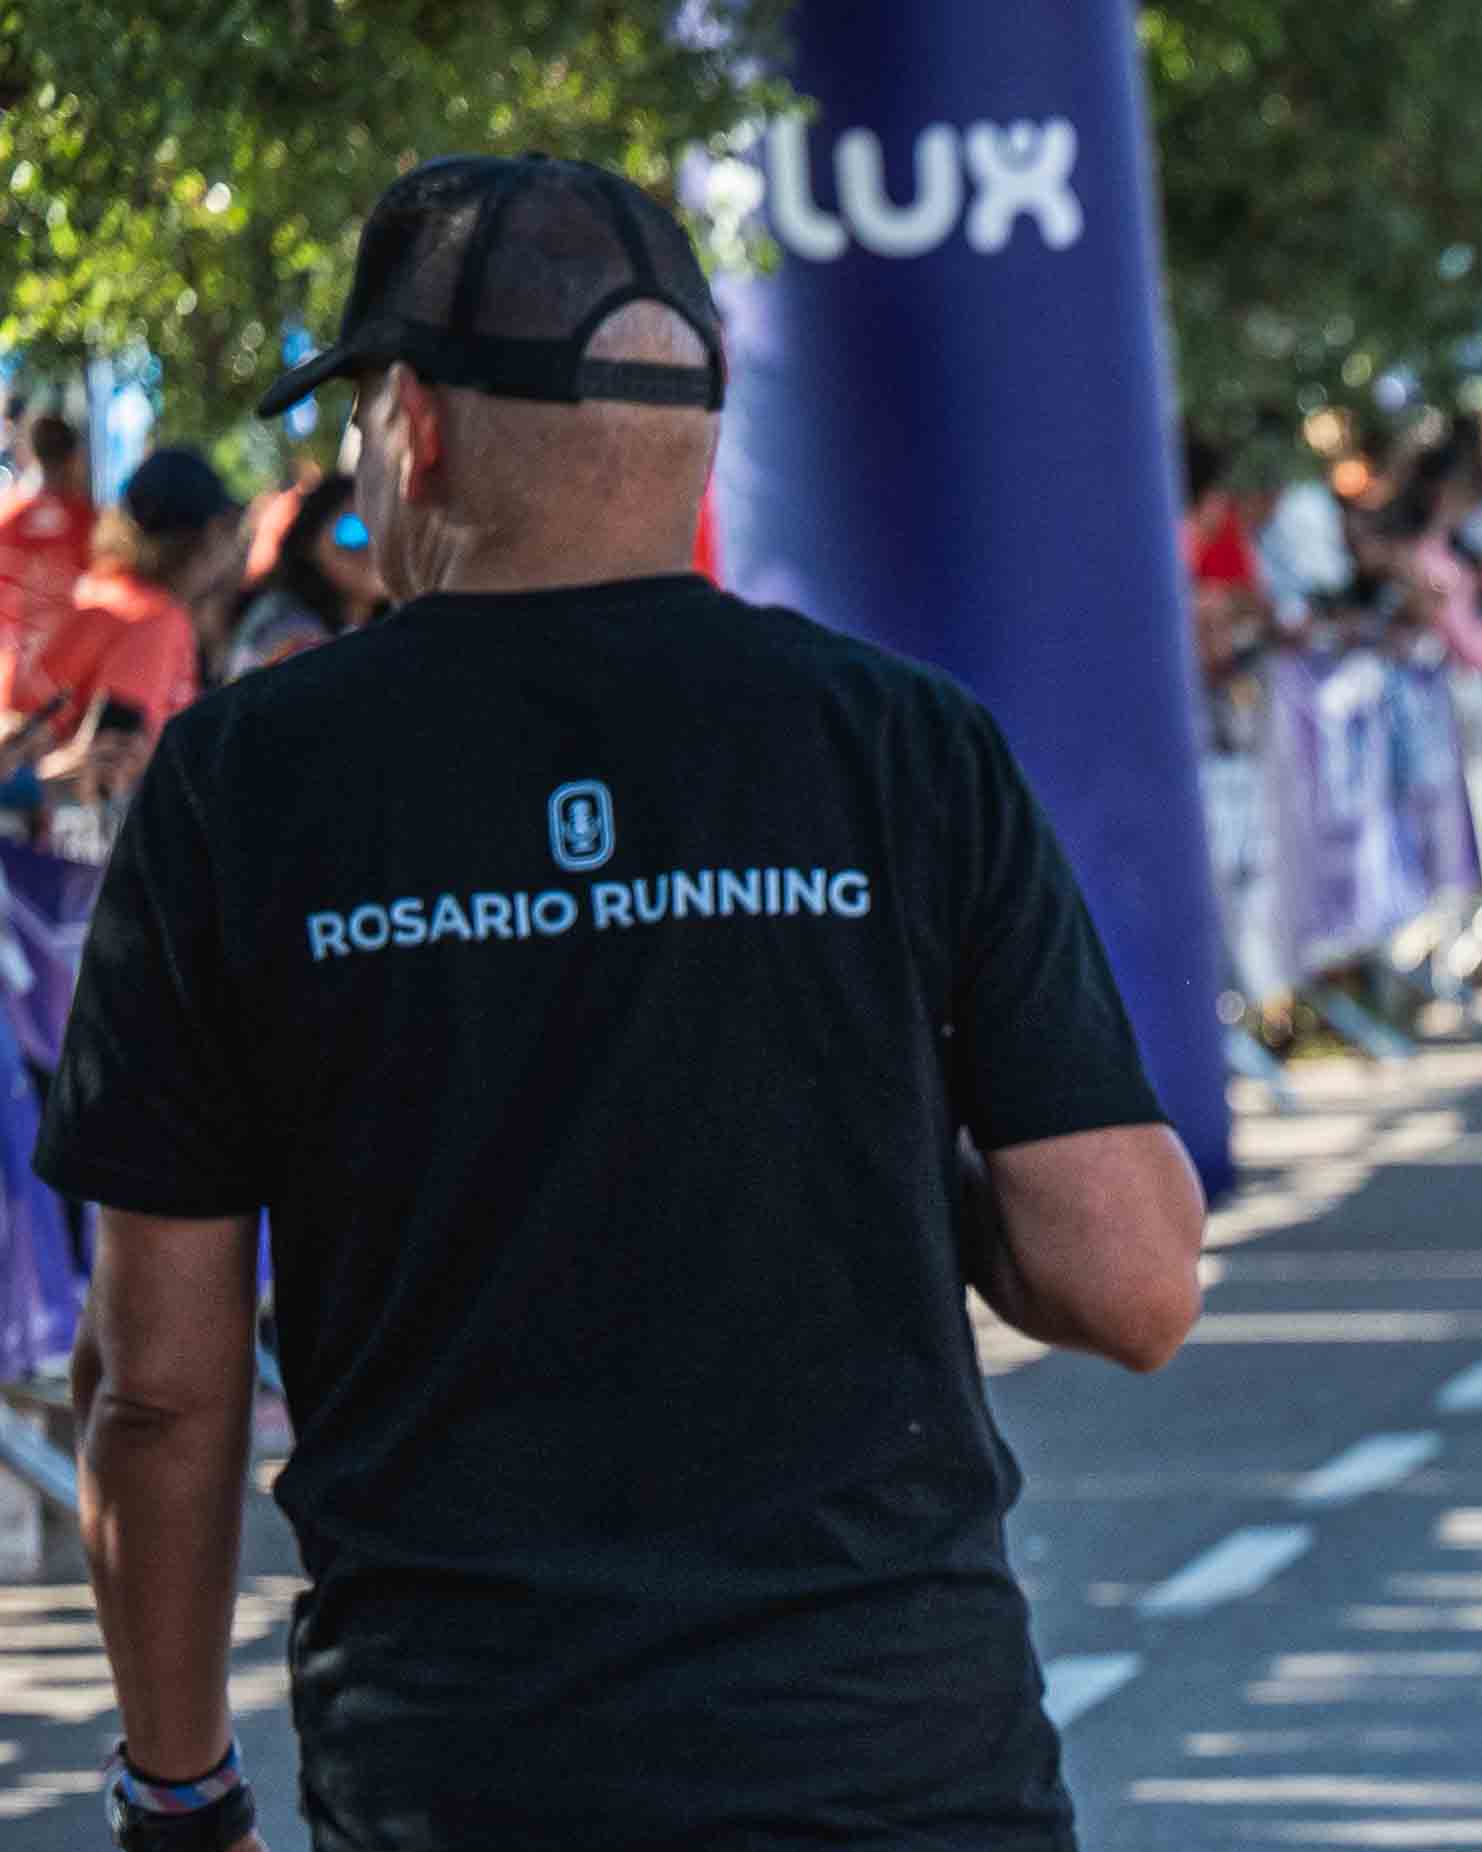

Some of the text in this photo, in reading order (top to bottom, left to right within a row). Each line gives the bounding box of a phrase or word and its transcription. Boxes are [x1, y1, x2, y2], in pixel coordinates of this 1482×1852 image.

[735, 112, 1084, 262] lux
[306, 867, 873, 961] ROSARIO RUNNING
